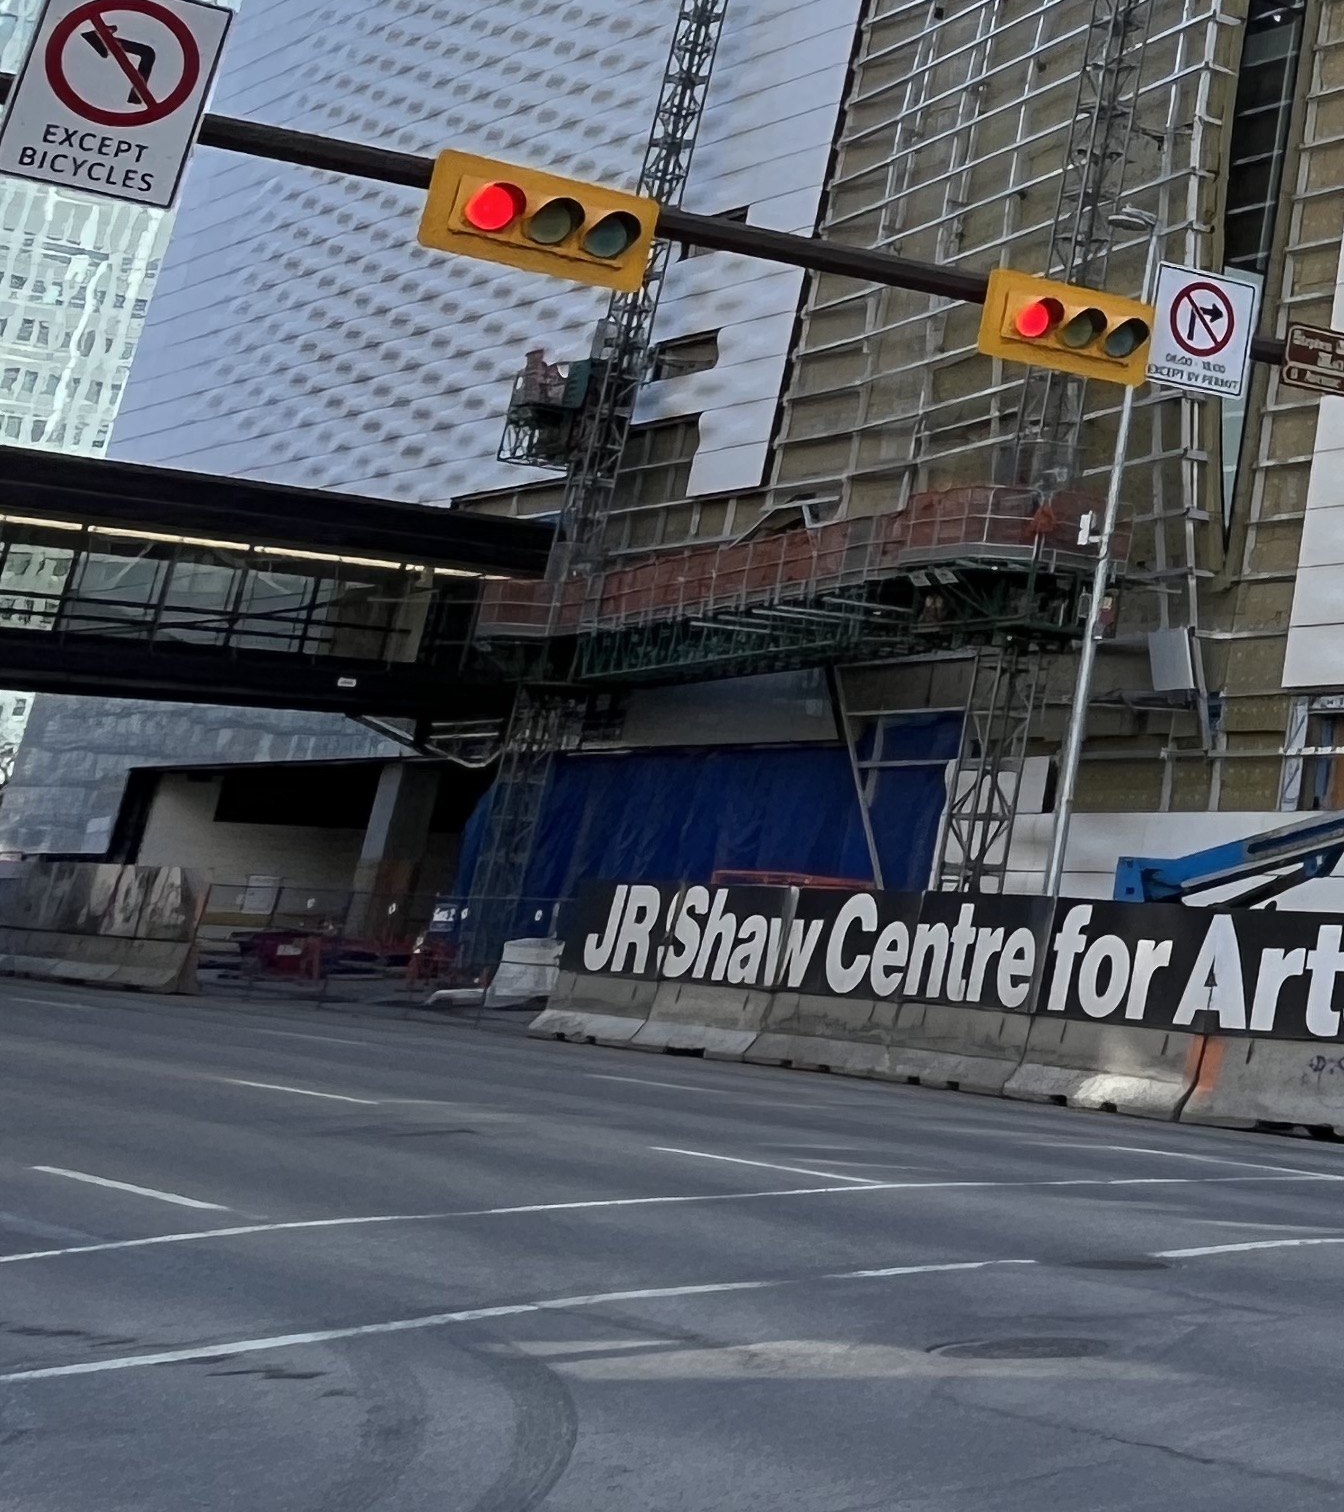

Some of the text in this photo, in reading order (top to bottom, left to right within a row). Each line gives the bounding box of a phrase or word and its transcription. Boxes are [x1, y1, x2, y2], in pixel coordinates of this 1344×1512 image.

[42, 123, 149, 163] EXCEPT
[18, 146, 155, 192] BICYCLES
[584, 884, 661, 974] JR
[657, 885, 824, 988] Shaw
[826, 893, 1036, 1008] Centre
[1047, 904, 1173, 1020] for
